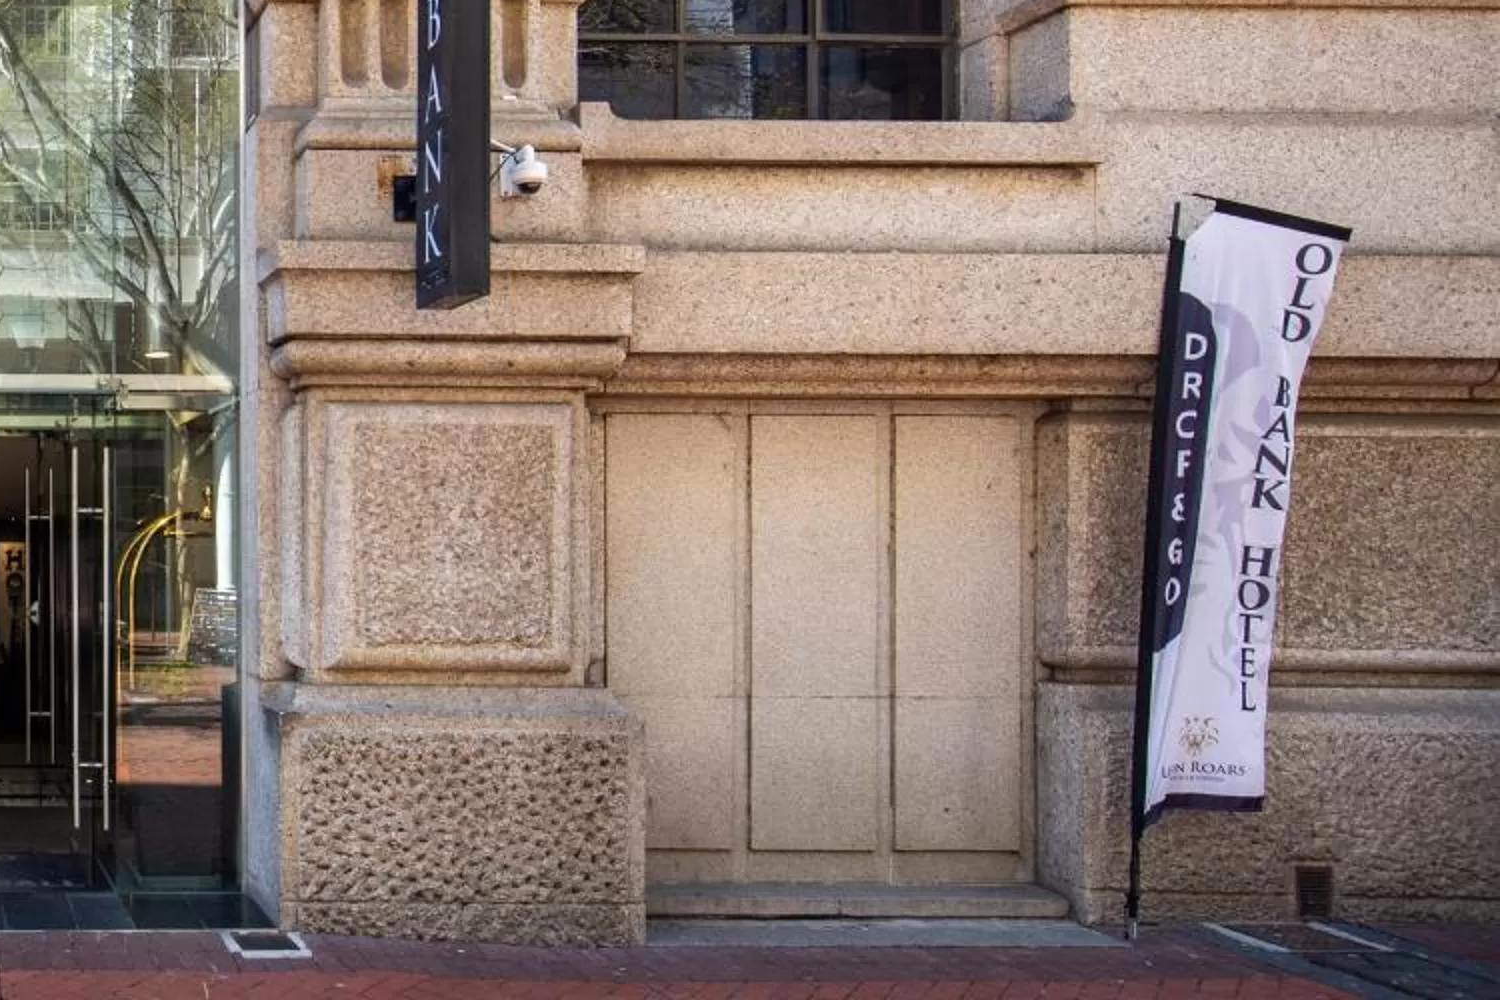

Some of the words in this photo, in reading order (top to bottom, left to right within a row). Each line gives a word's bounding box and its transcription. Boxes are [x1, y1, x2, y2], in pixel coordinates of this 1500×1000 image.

[1281, 243, 1334, 344] OLD
[1251, 376, 1291, 512] BANK
[1239, 546, 1273, 713] HOTEL
[1190, 760, 1248, 776] ROARS
